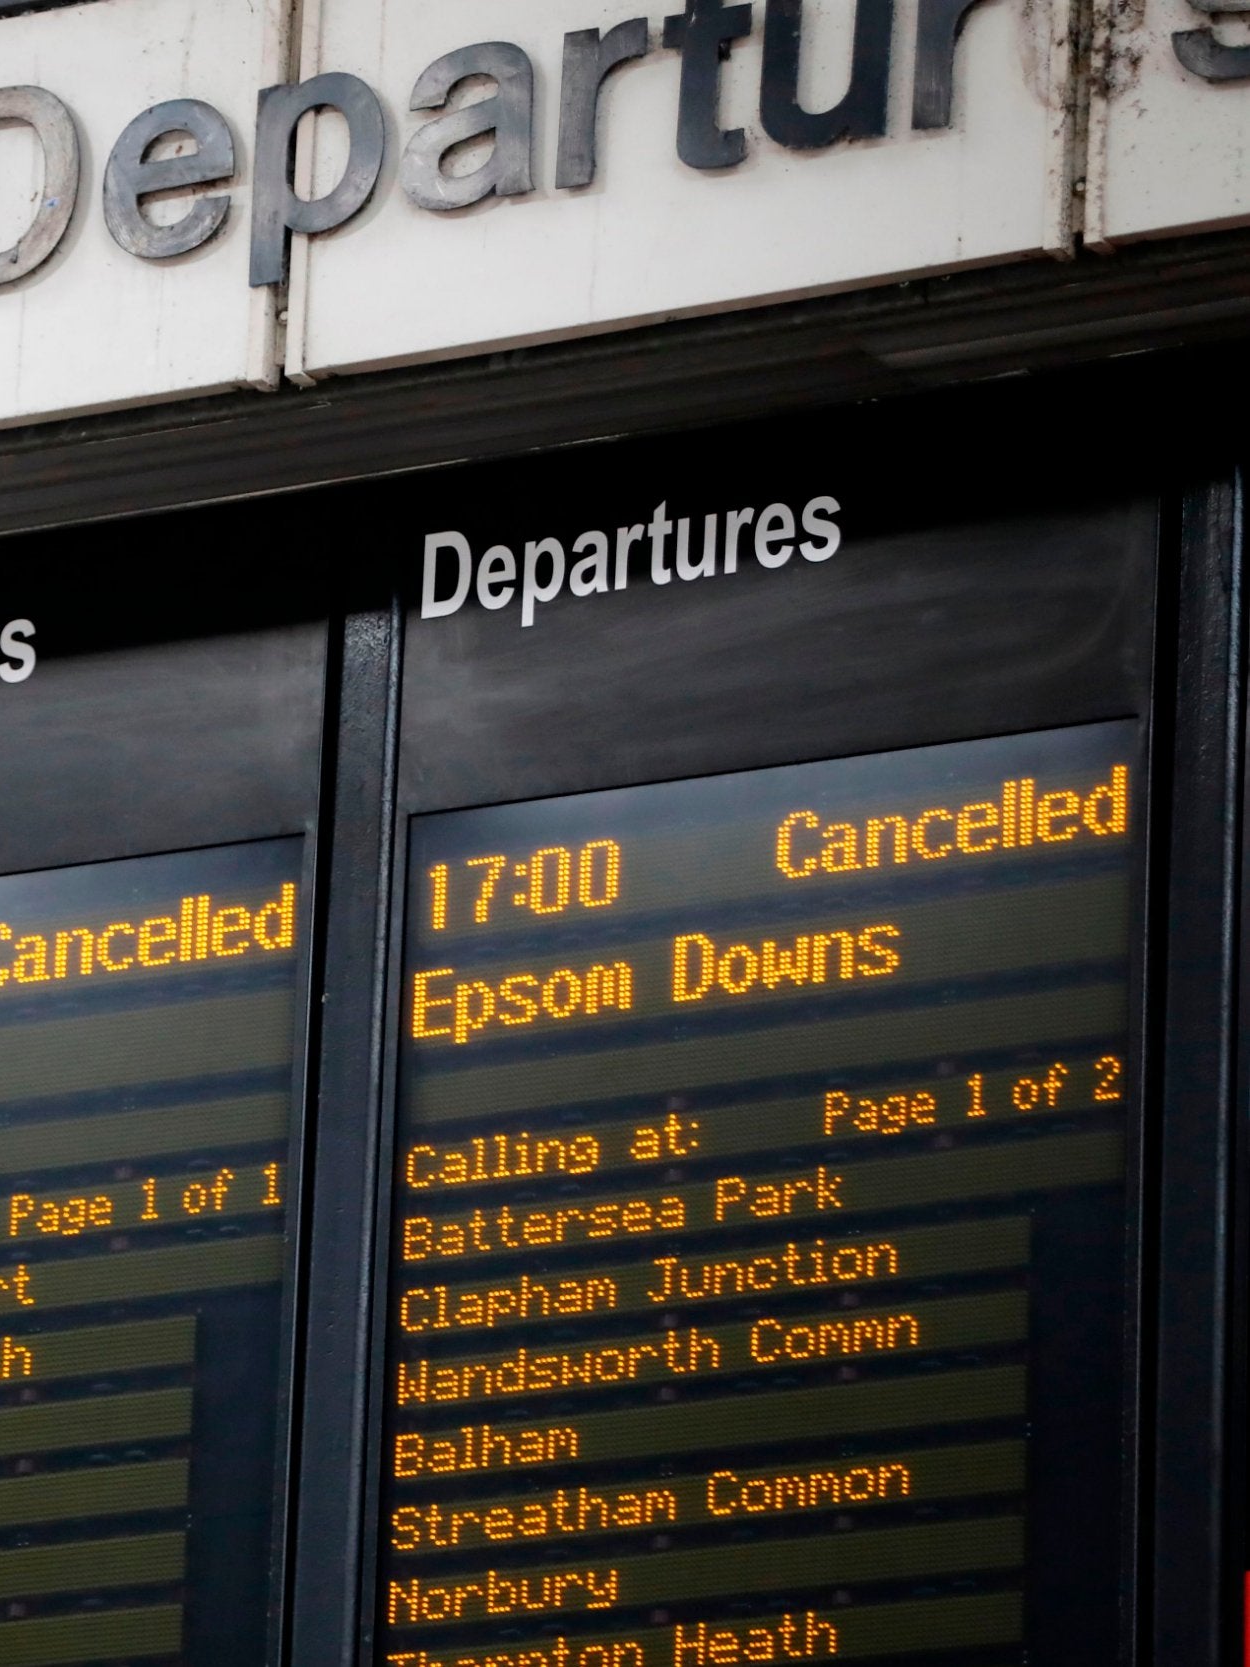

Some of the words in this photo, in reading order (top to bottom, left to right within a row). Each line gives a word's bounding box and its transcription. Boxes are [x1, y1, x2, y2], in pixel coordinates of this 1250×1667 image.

[420, 495, 841, 628] Departures
[428, 839, 621, 931] 17:00
[775, 764, 1128, 880] Cancelled
[411, 961, 634, 1045] Epsom
[671, 923, 901, 1003] Downs
[406, 1131, 600, 1189] Calling
[629, 1113, 699, 1161] at:
[824, 1091, 936, 1135] Page
[967, 1073, 987, 1117] 1
[1012, 1063, 1069, 1111] of
[1094, 1056, 1121, 1101] 2
[9, 1193, 113, 1237] Page
[140, 1177, 159, 1221] 1
[182, 1168, 235, 1215] of
[261, 1162, 281, 1205] 1
[403, 1196, 685, 1261] Battersea
[715, 1166, 842, 1222] Park
[400, 1275, 617, 1332] Clapham
[646, 1239, 897, 1303] Junction
[397, 1327, 720, 1405] Wandsworth
[750, 1314, 918, 1363] Commn
[394, 1424, 578, 1478] Balham
[391, 1487, 676, 1550] Streatham
[707, 1464, 910, 1516] Common
[388, 1569, 618, 1624] Norbury
[674, 1611, 837, 1667] Heath
